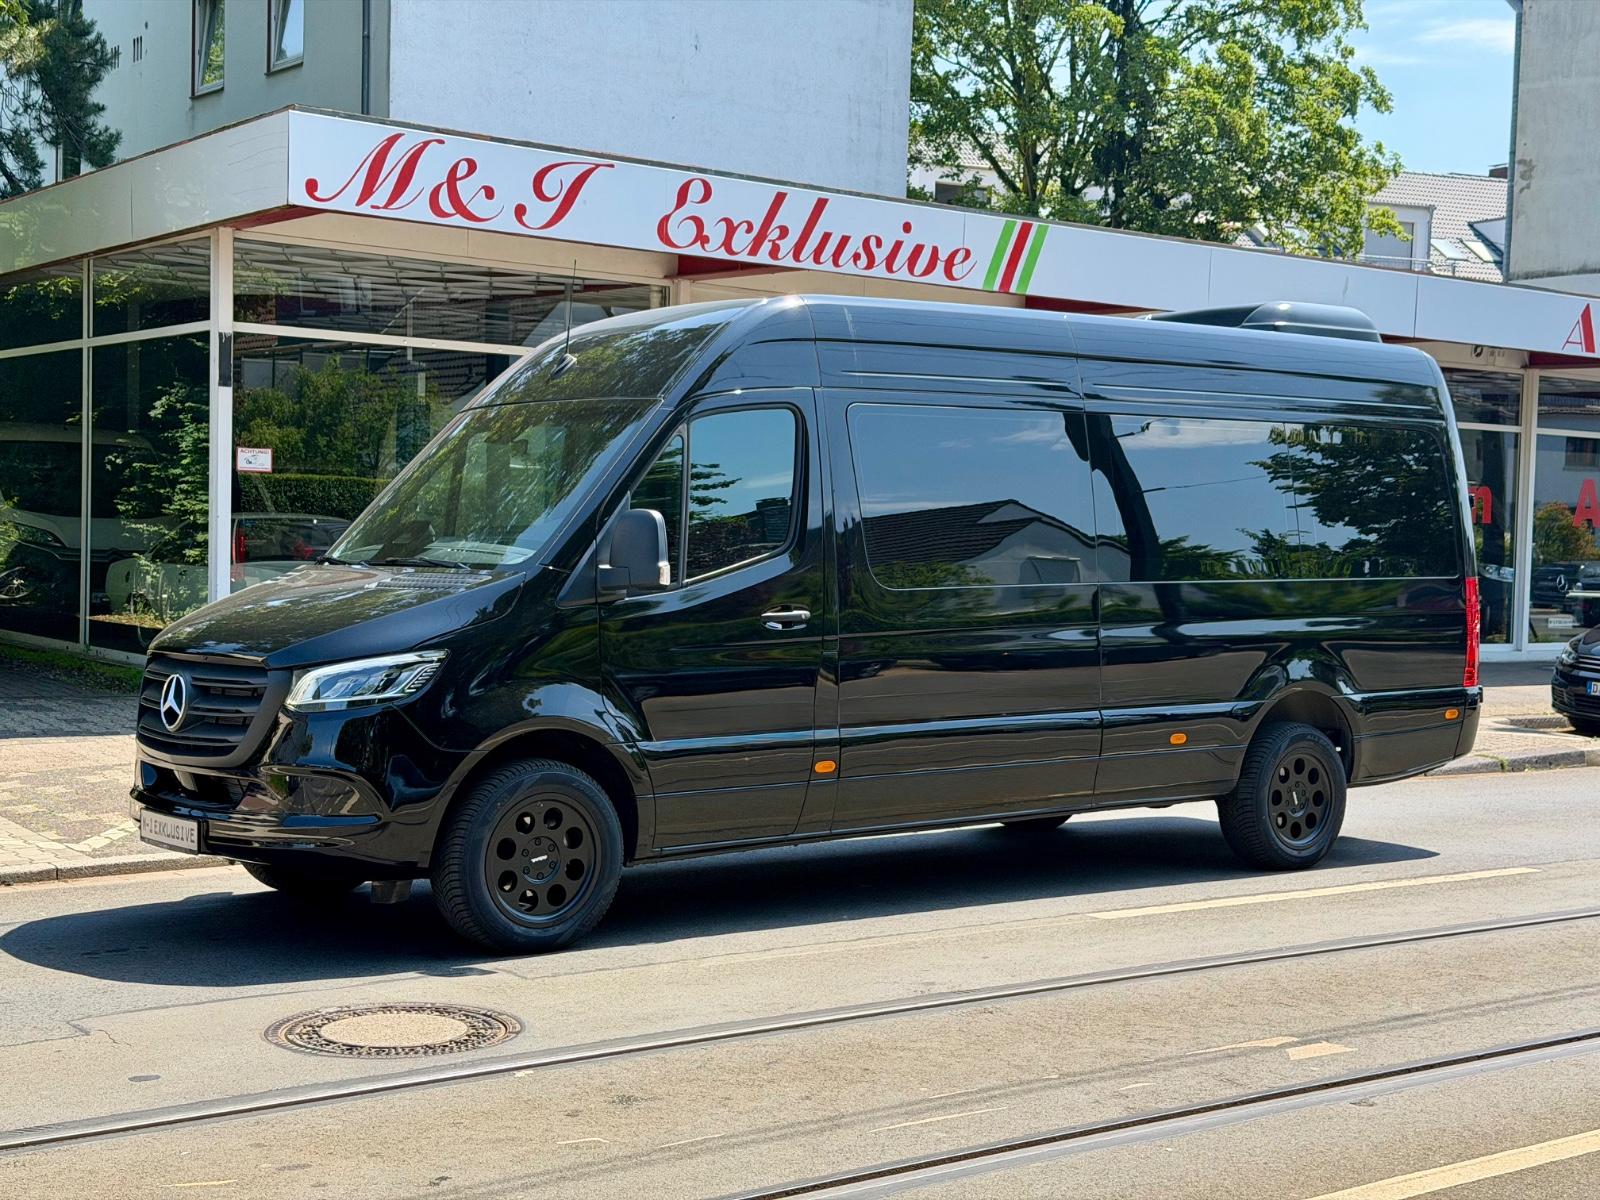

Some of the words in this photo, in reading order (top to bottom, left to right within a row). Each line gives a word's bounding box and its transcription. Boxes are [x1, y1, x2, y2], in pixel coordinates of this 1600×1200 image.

[305, 132, 446, 211] M
[428, 157, 505, 223] &
[656, 177, 978, 281] Exklusive
